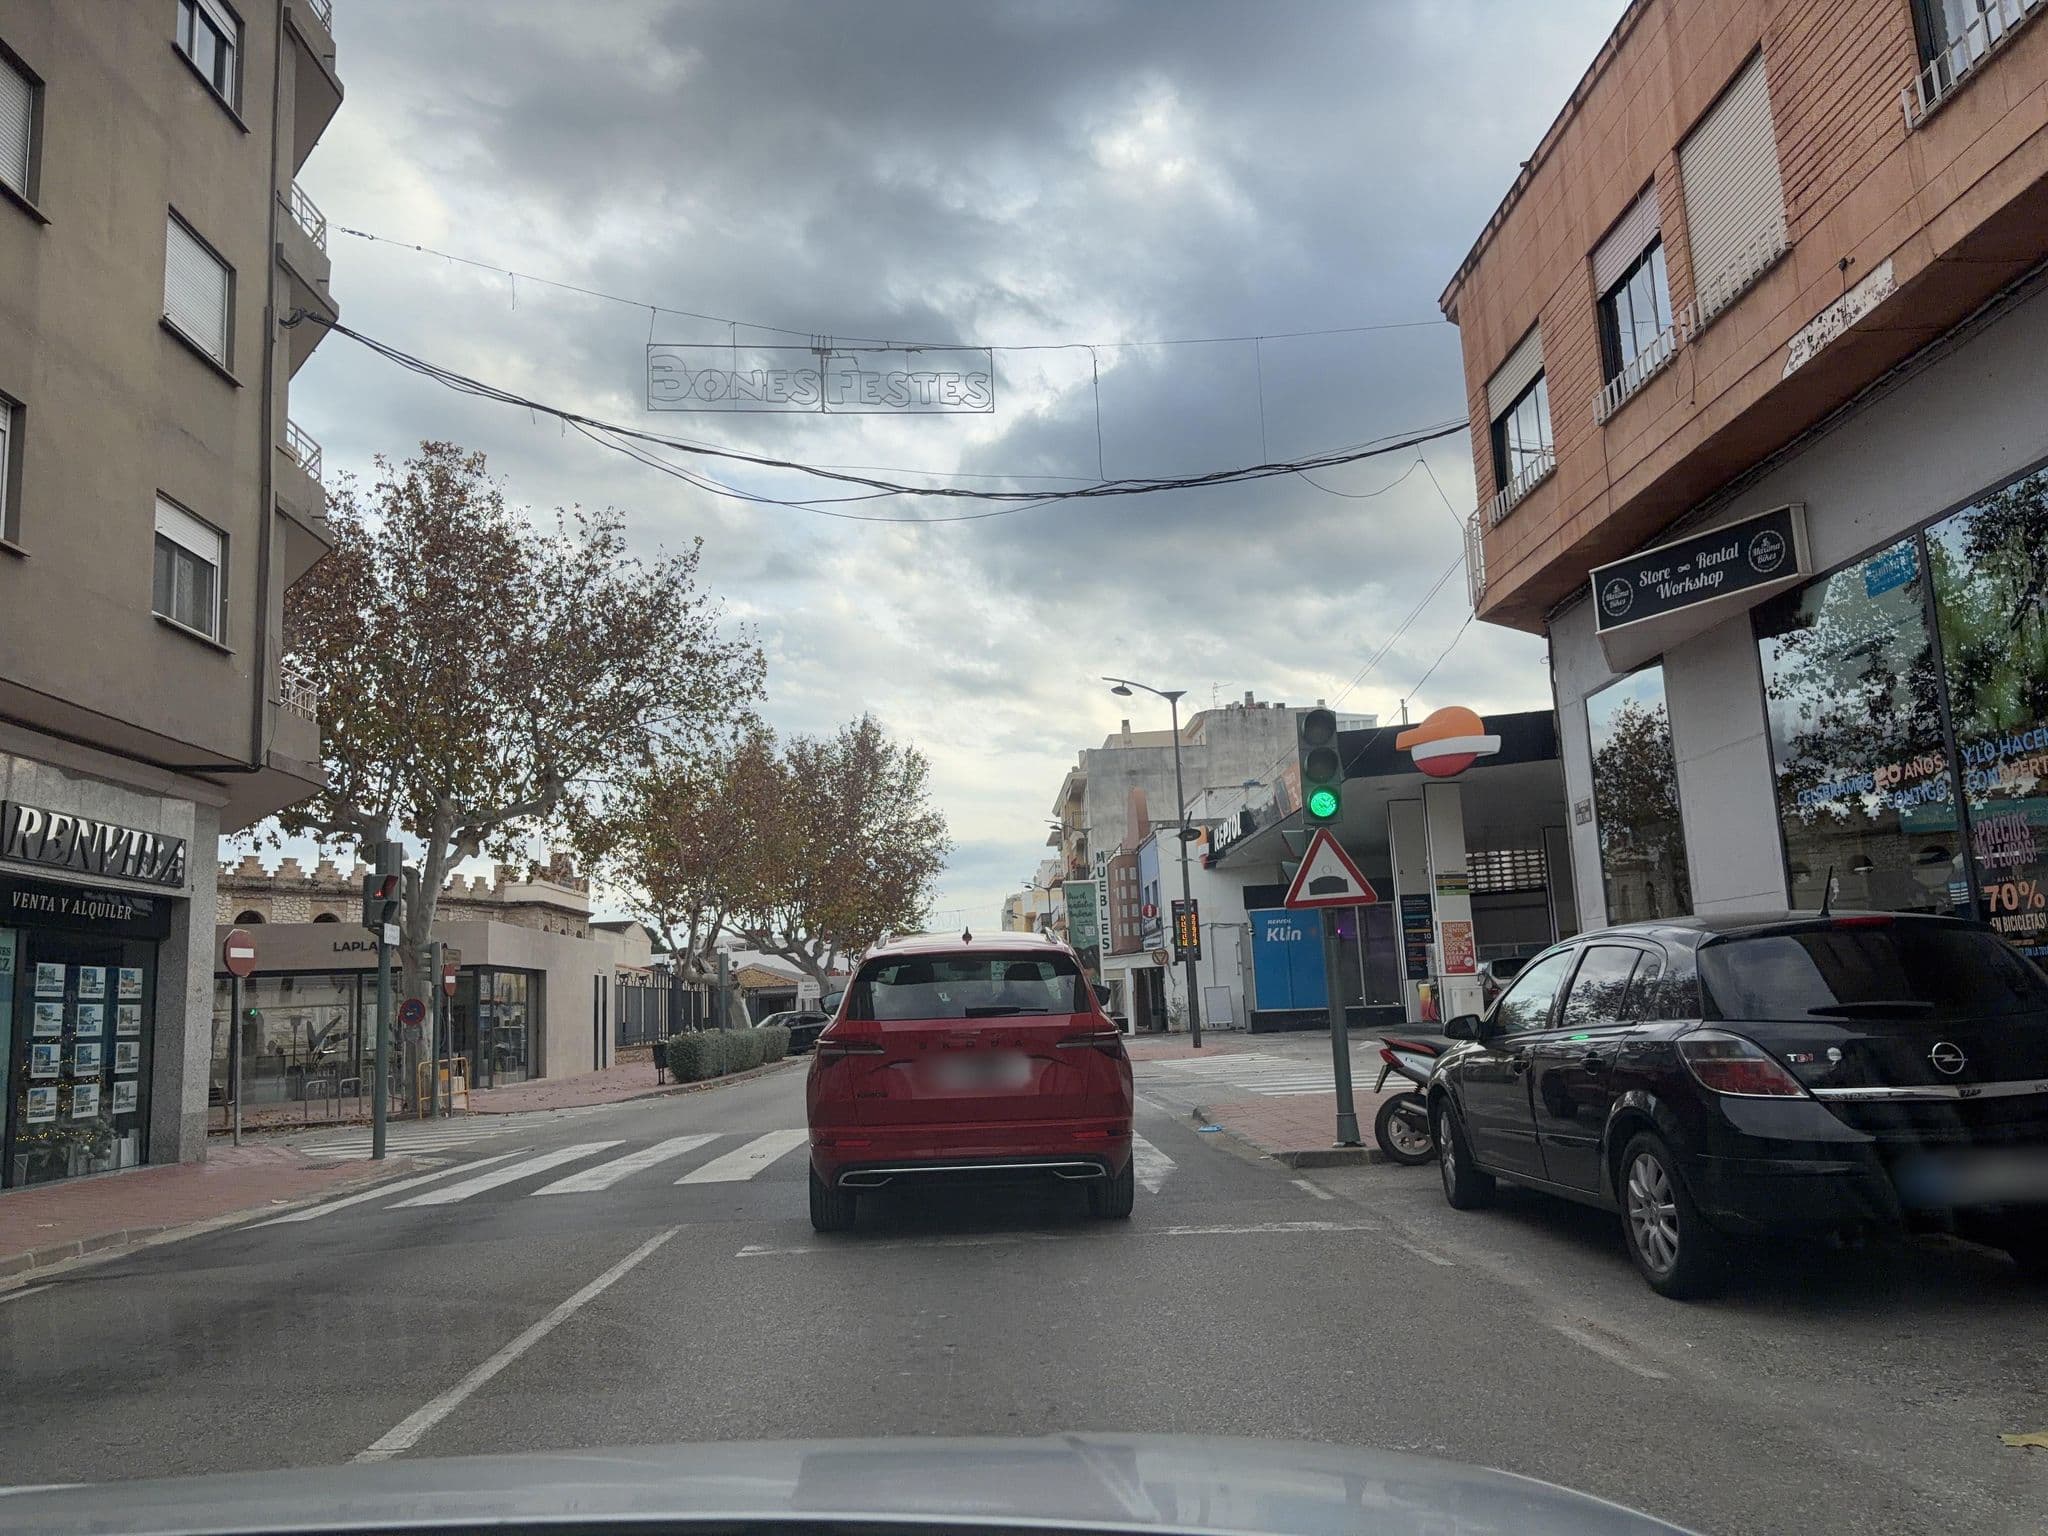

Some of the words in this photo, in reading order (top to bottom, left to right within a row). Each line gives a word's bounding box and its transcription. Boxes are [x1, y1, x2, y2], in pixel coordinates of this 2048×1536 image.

[651, 354, 819, 405] BONES
[825, 356, 990, 407] FESTES
[1639, 567, 1671, 587] Store
[1695, 542, 1739, 569] Rental
[1757, 553, 1777, 565] Bikes
[1656, 570, 1724, 599] Workshop
[1609, 597, 1626, 609] Bikes
[1874, 763, 1902, 788] 20
[1904, 754, 1944, 780] AÑOS
[1886, 777, 1948, 809] CONTIGO
[7, 805, 186, 883] RENVIDA
[1213, 811, 1242, 852] REPSOL
[1983, 844, 1997, 870] DE
[12, 891, 55, 913] VENTA
[61, 898, 71, 913] Y
[72, 900, 132, 921] ALQUILER
[1096, 851, 1110, 950] MUEBLES
[1983, 879, 2046, 912] 70%
[1266, 926, 1301, 942] Klin
